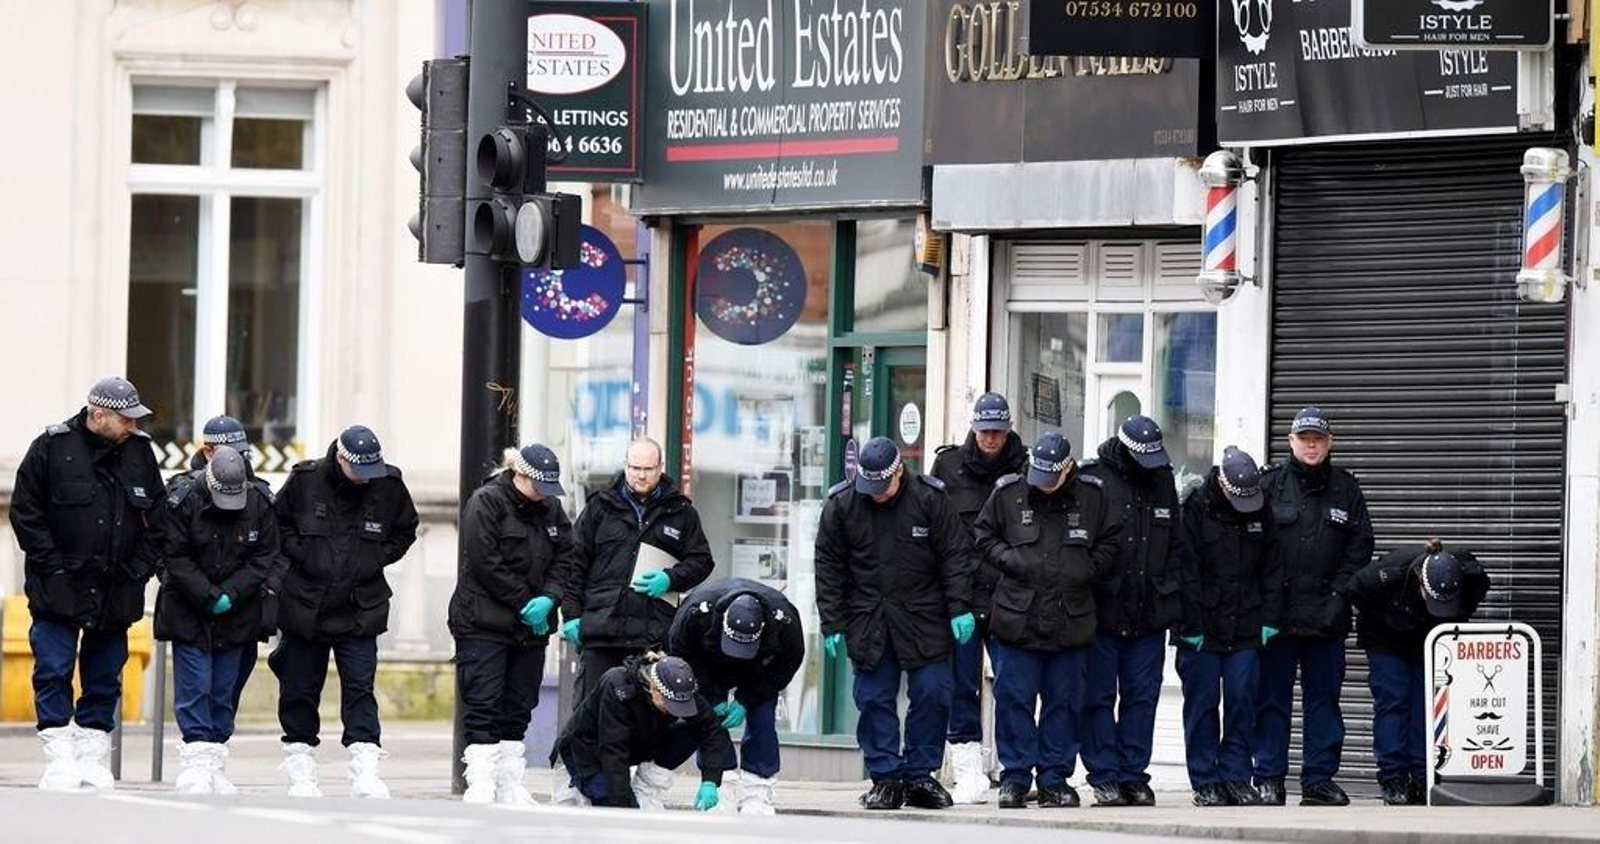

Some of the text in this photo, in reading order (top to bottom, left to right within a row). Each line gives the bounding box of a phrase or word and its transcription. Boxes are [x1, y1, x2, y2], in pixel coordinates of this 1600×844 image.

[1066, 2, 1197, 18] 07534 672100
[1420, 15, 1493, 30] ISTYLE
[1424, 33, 1490, 41] HAIR FOR MEN
[668, 0, 903, 96] United Estates
[1439, 49, 1488, 76] ISTYLE
[1234, 62, 1277, 92] ISTYLE
[1445, 83, 1488, 98] JUST FOR HAIR
[1238, 98, 1278, 113] HAIR FOR MEN
[554, 110, 628, 126] LETTINGS
[667, 98, 900, 138] RESIDENTIAL & COMMERCIAL PROPERTY SERVICES
[579, 137, 622, 154] 6636
[724, 161, 837, 190] www.unitedestatesltd.co.uk
[1457, 642, 1521, 660] BARBERS
[1470, 698, 1506, 708] HAIR CUT
[1476, 725, 1500, 735] SHAVE
[1471, 754, 1504, 769] OPEN
